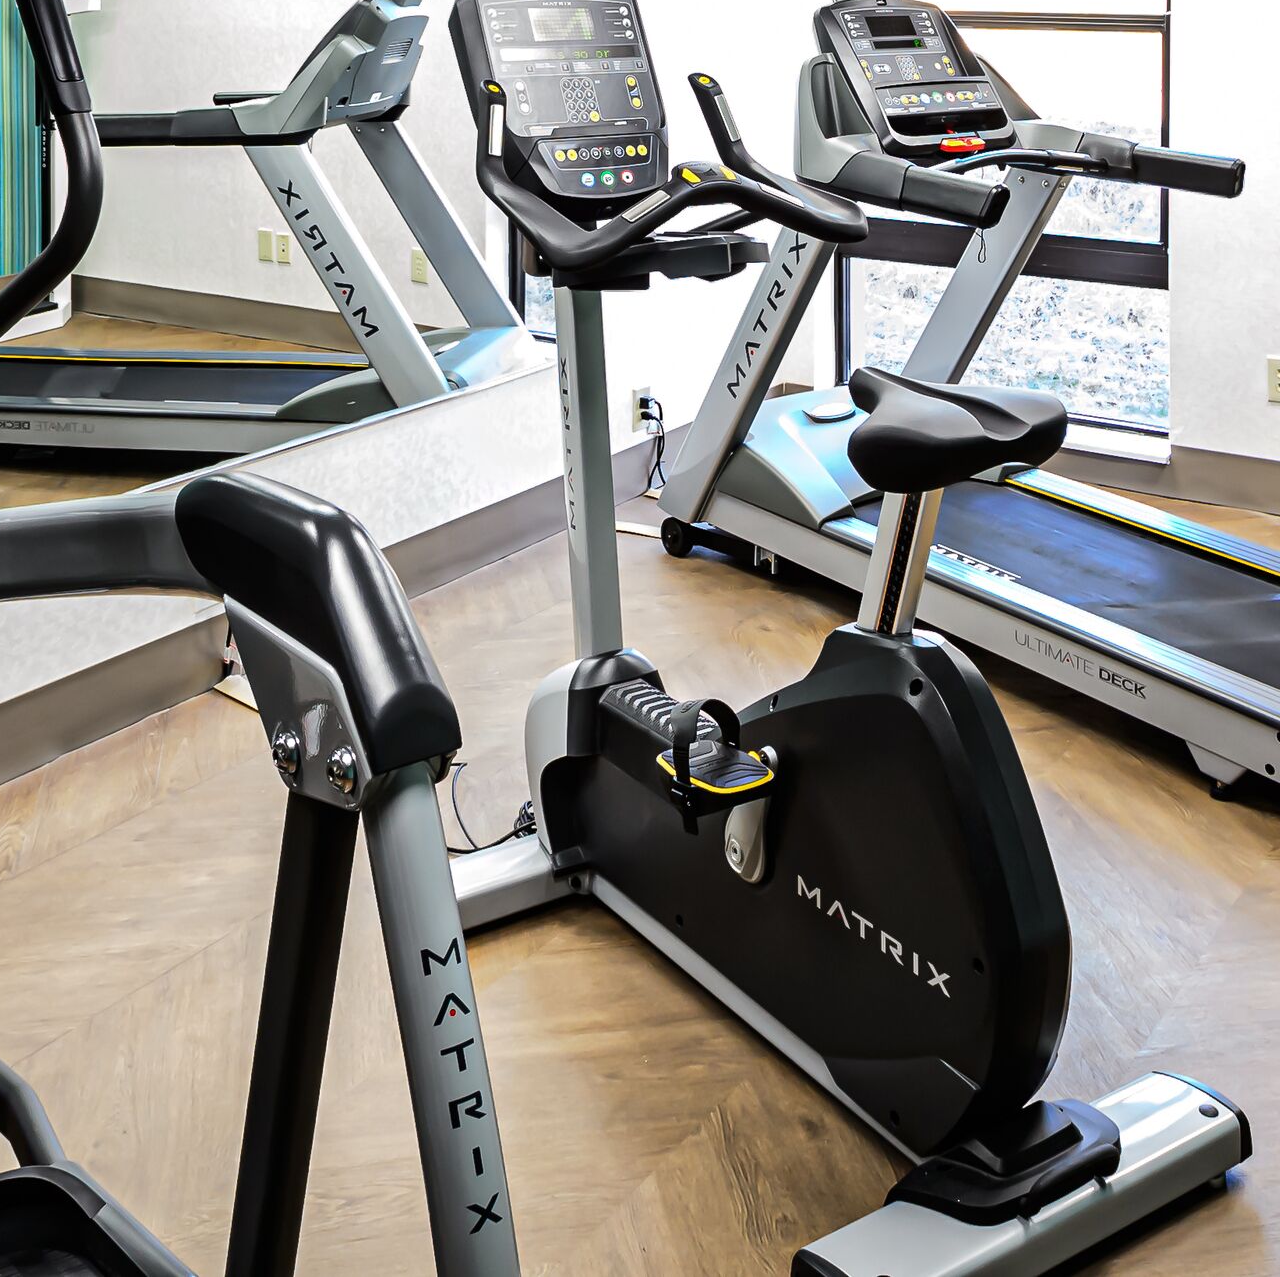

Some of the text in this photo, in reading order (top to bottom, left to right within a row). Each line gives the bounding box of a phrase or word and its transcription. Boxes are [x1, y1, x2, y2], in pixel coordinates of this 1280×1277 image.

[726, 232, 808, 399] MATRIX
[1014, 629, 1147, 700] ULTIMATE DECK
[797, 874, 952, 999] MATRIX
[420, 937, 504, 1235] MATRIX
